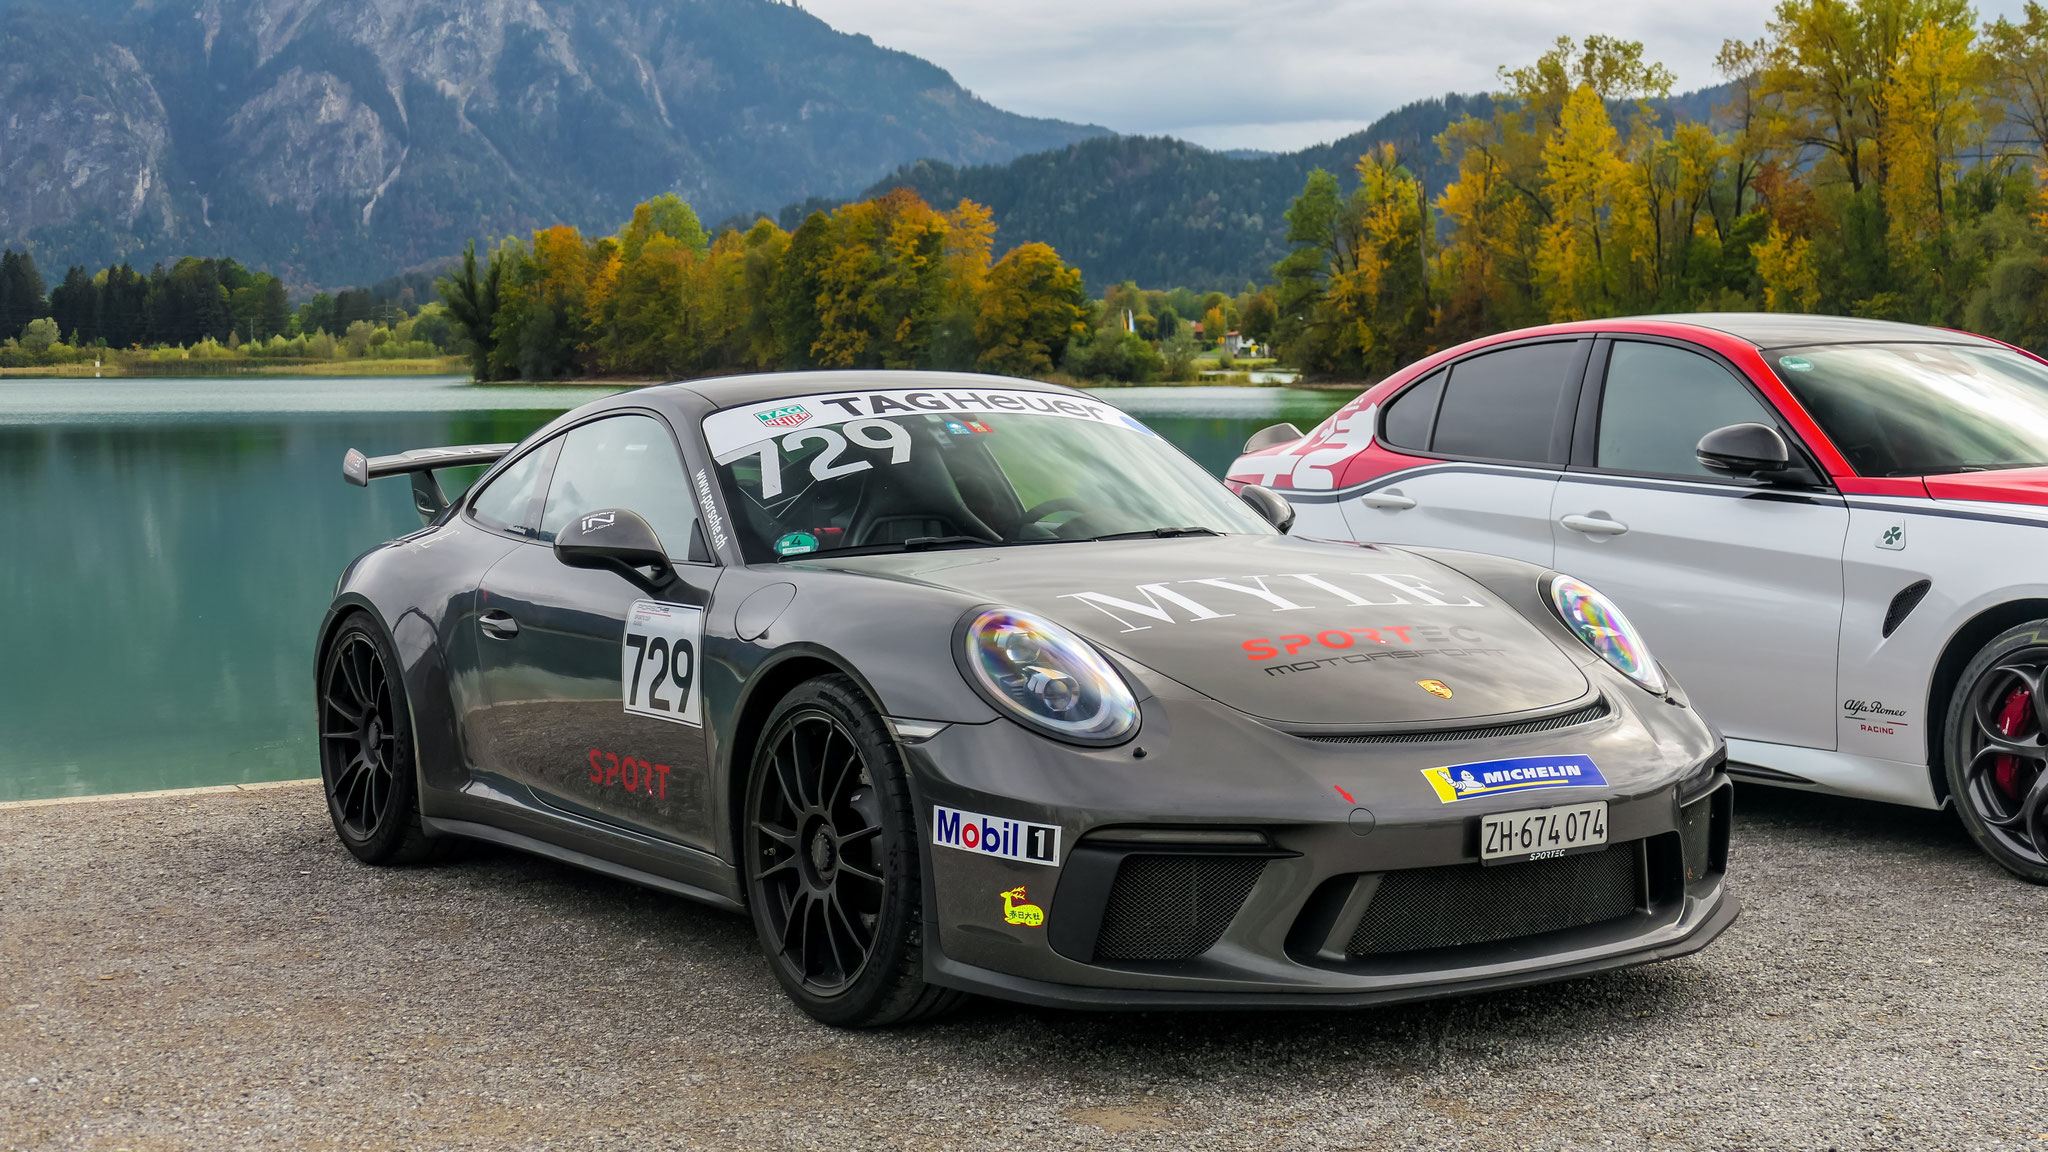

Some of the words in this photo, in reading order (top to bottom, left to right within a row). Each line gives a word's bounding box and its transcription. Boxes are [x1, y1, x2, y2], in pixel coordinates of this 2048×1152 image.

[760, 407, 801, 419] TAG
[765, 412, 809, 426] HEUER
[714, 418, 912, 500] 729
[696, 468, 728, 550] www.porsche.ch
[790, 535, 802, 546] 4
[1056, 572, 1485, 633] MYLE
[1241, 625, 1481, 661] SPORTEC
[626, 633, 695, 714] 729
[1264, 648, 1505, 676] MOTORSPORT
[1844, 699, 1870, 716] Alfa
[1869, 701, 1907, 717] Romeo
[1860, 724, 1894, 735] RACING
[1483, 765, 1582, 784] MICHELIN
[937, 808, 1019, 857] Mobil
[1034, 829, 1046, 858] 1
[1529, 849, 1566, 861] SPORTEC
